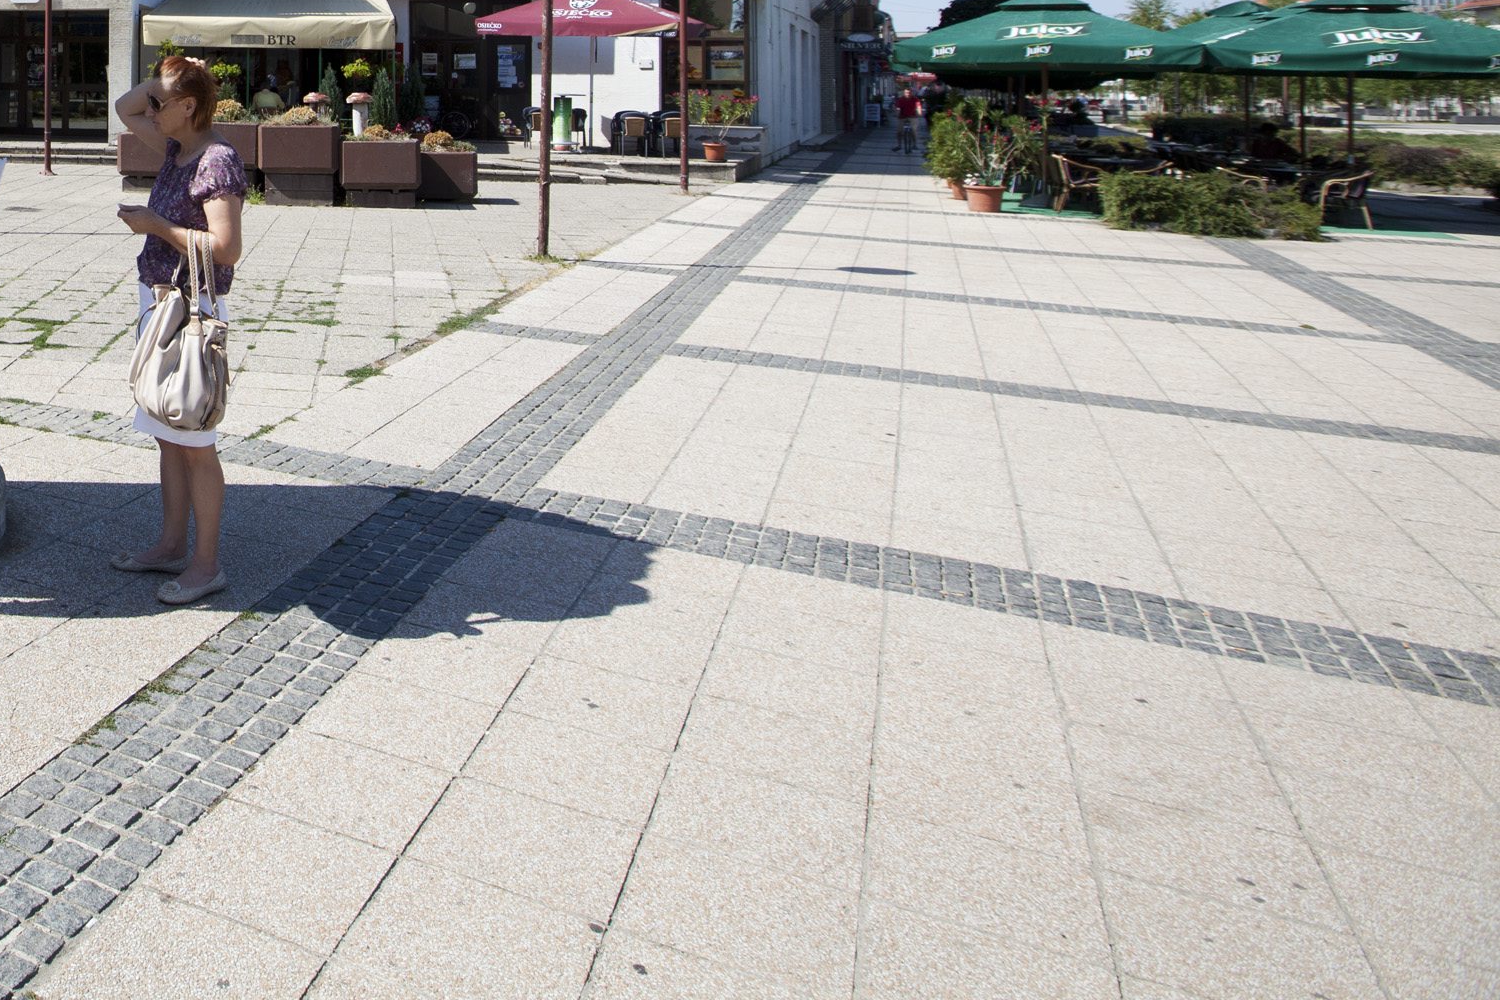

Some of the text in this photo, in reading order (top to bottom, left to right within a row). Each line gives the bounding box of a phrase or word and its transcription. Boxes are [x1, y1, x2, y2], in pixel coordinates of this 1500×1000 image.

[1004, 24, 1083, 38] Juicy
[1334, 28, 1423, 44] Juicy
[267, 35, 296, 45] BTR
[932, 45, 1153, 59] Juicy Juicy Juicy
[1252, 52, 1400, 65] Juicy Juicy
